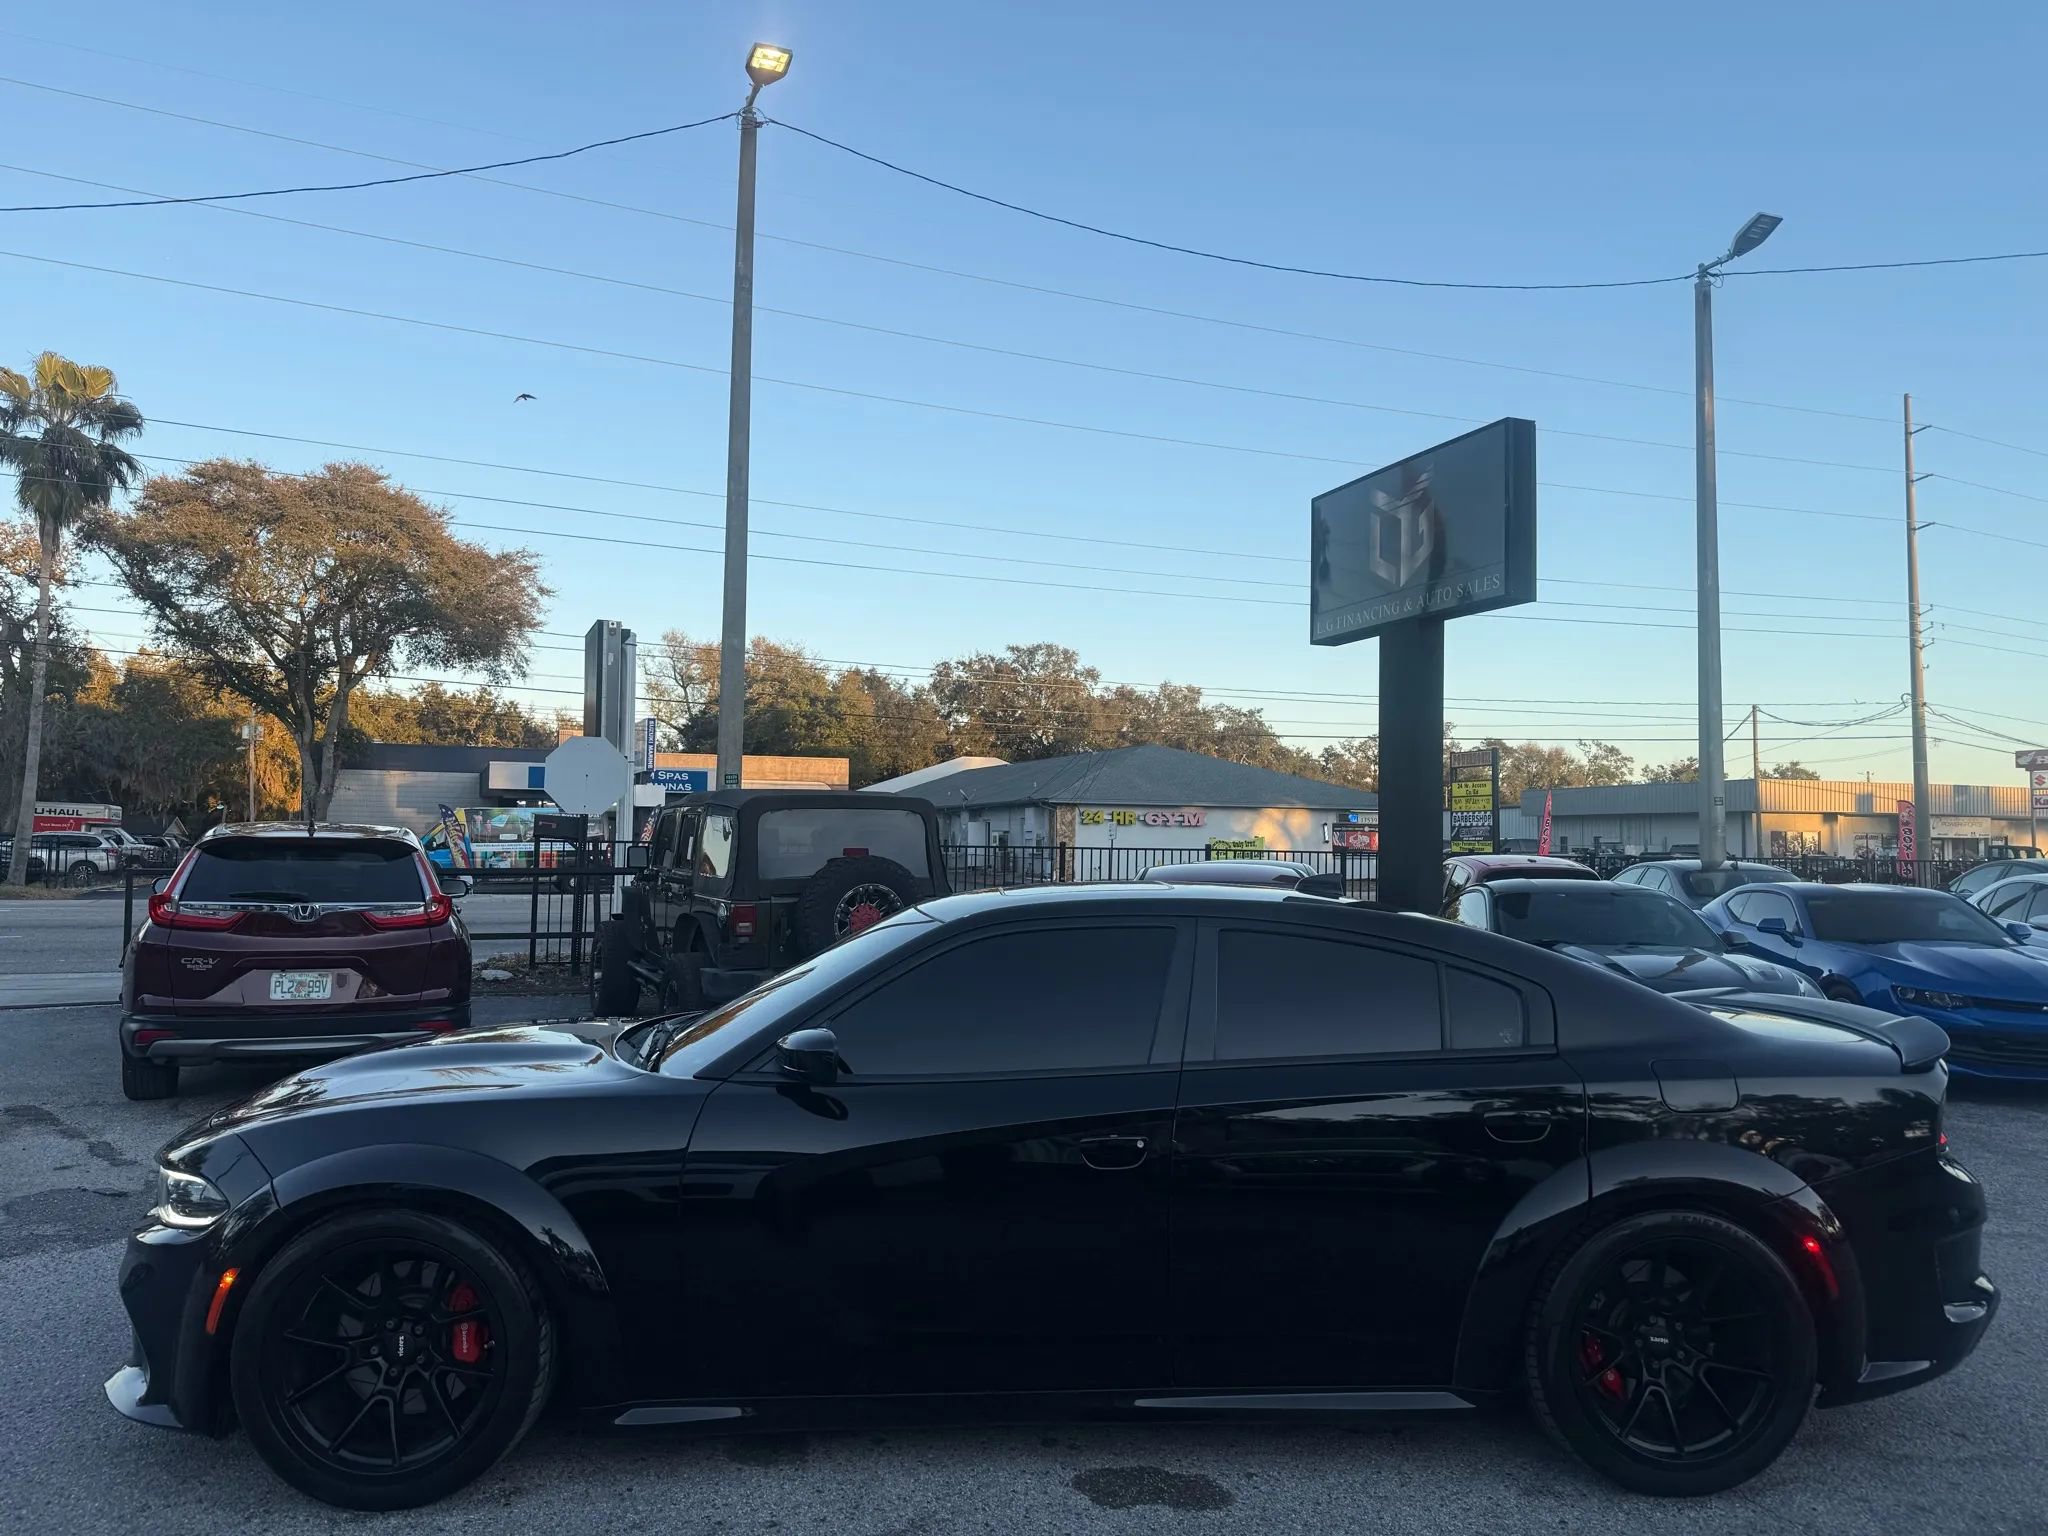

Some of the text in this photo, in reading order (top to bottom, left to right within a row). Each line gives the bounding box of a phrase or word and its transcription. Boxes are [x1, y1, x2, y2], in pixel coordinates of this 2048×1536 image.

[1336, 600, 1400, 629] FINANCING
[1403, 597, 1413, 612] &
[1416, 586, 1453, 609] AUTO
[1456, 573, 1501, 598] SALES
[658, 771, 689, 780] SPAS
[34, 807, 83, 816] U-HAUL
[1081, 809, 1207, 827] 24 HR GYM
[1453, 814, 1492, 823] BARBERSHOP
[181, 957, 220, 965] CR-V
